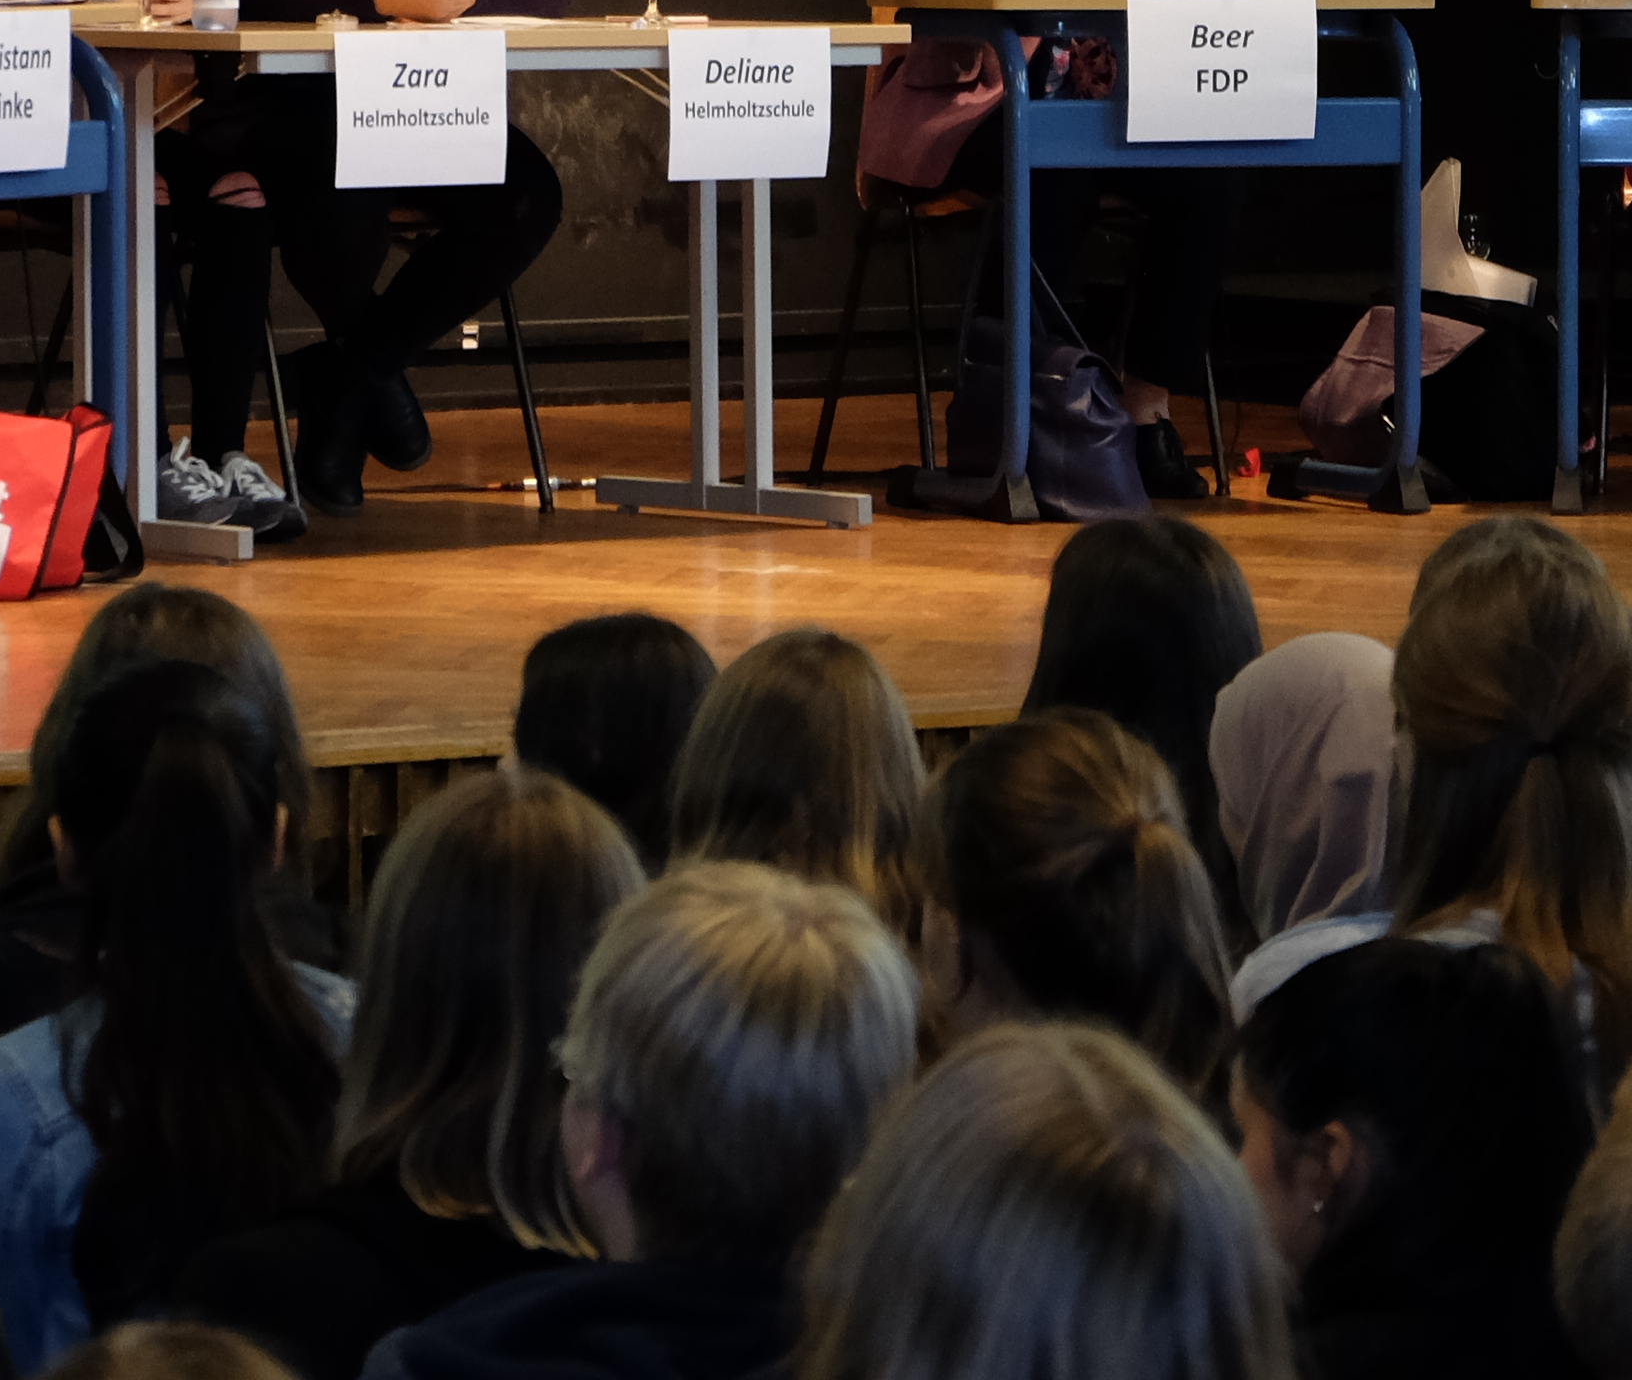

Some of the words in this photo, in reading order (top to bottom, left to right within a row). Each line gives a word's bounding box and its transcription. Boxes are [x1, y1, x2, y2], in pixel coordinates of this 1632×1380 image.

[1190, 24, 1255, 48] Beer
[392, 62, 449, 89] Zara
[705, 57, 795, 84] Deliane
[1196, 69, 1249, 93] FDP
[352, 106, 490, 129] Helmholtzschule
[684, 99, 815, 119] Helmholtzschule
